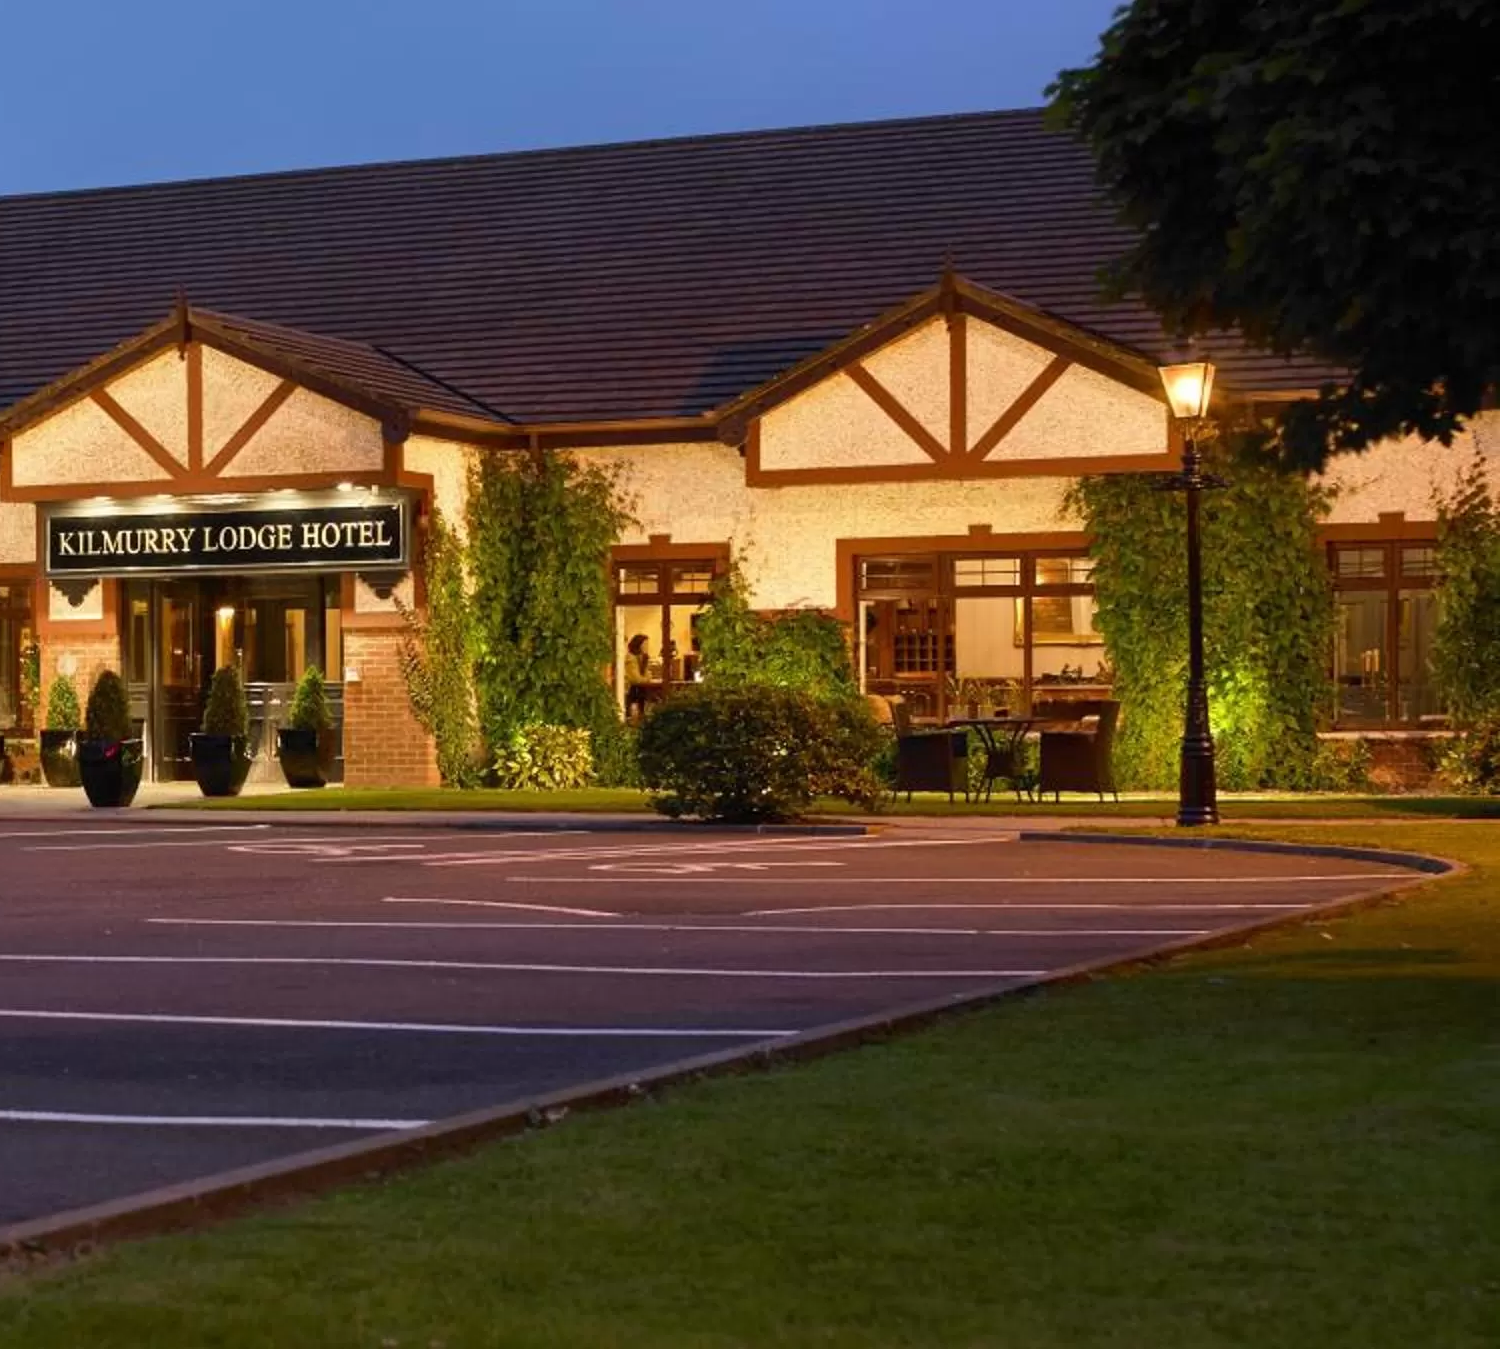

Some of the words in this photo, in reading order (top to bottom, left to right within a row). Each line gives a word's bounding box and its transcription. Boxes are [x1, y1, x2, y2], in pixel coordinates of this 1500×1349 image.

[58, 527, 195, 556] KILMURRY
[202, 523, 293, 551] LODGE
[300, 519, 392, 548] HOTEL
